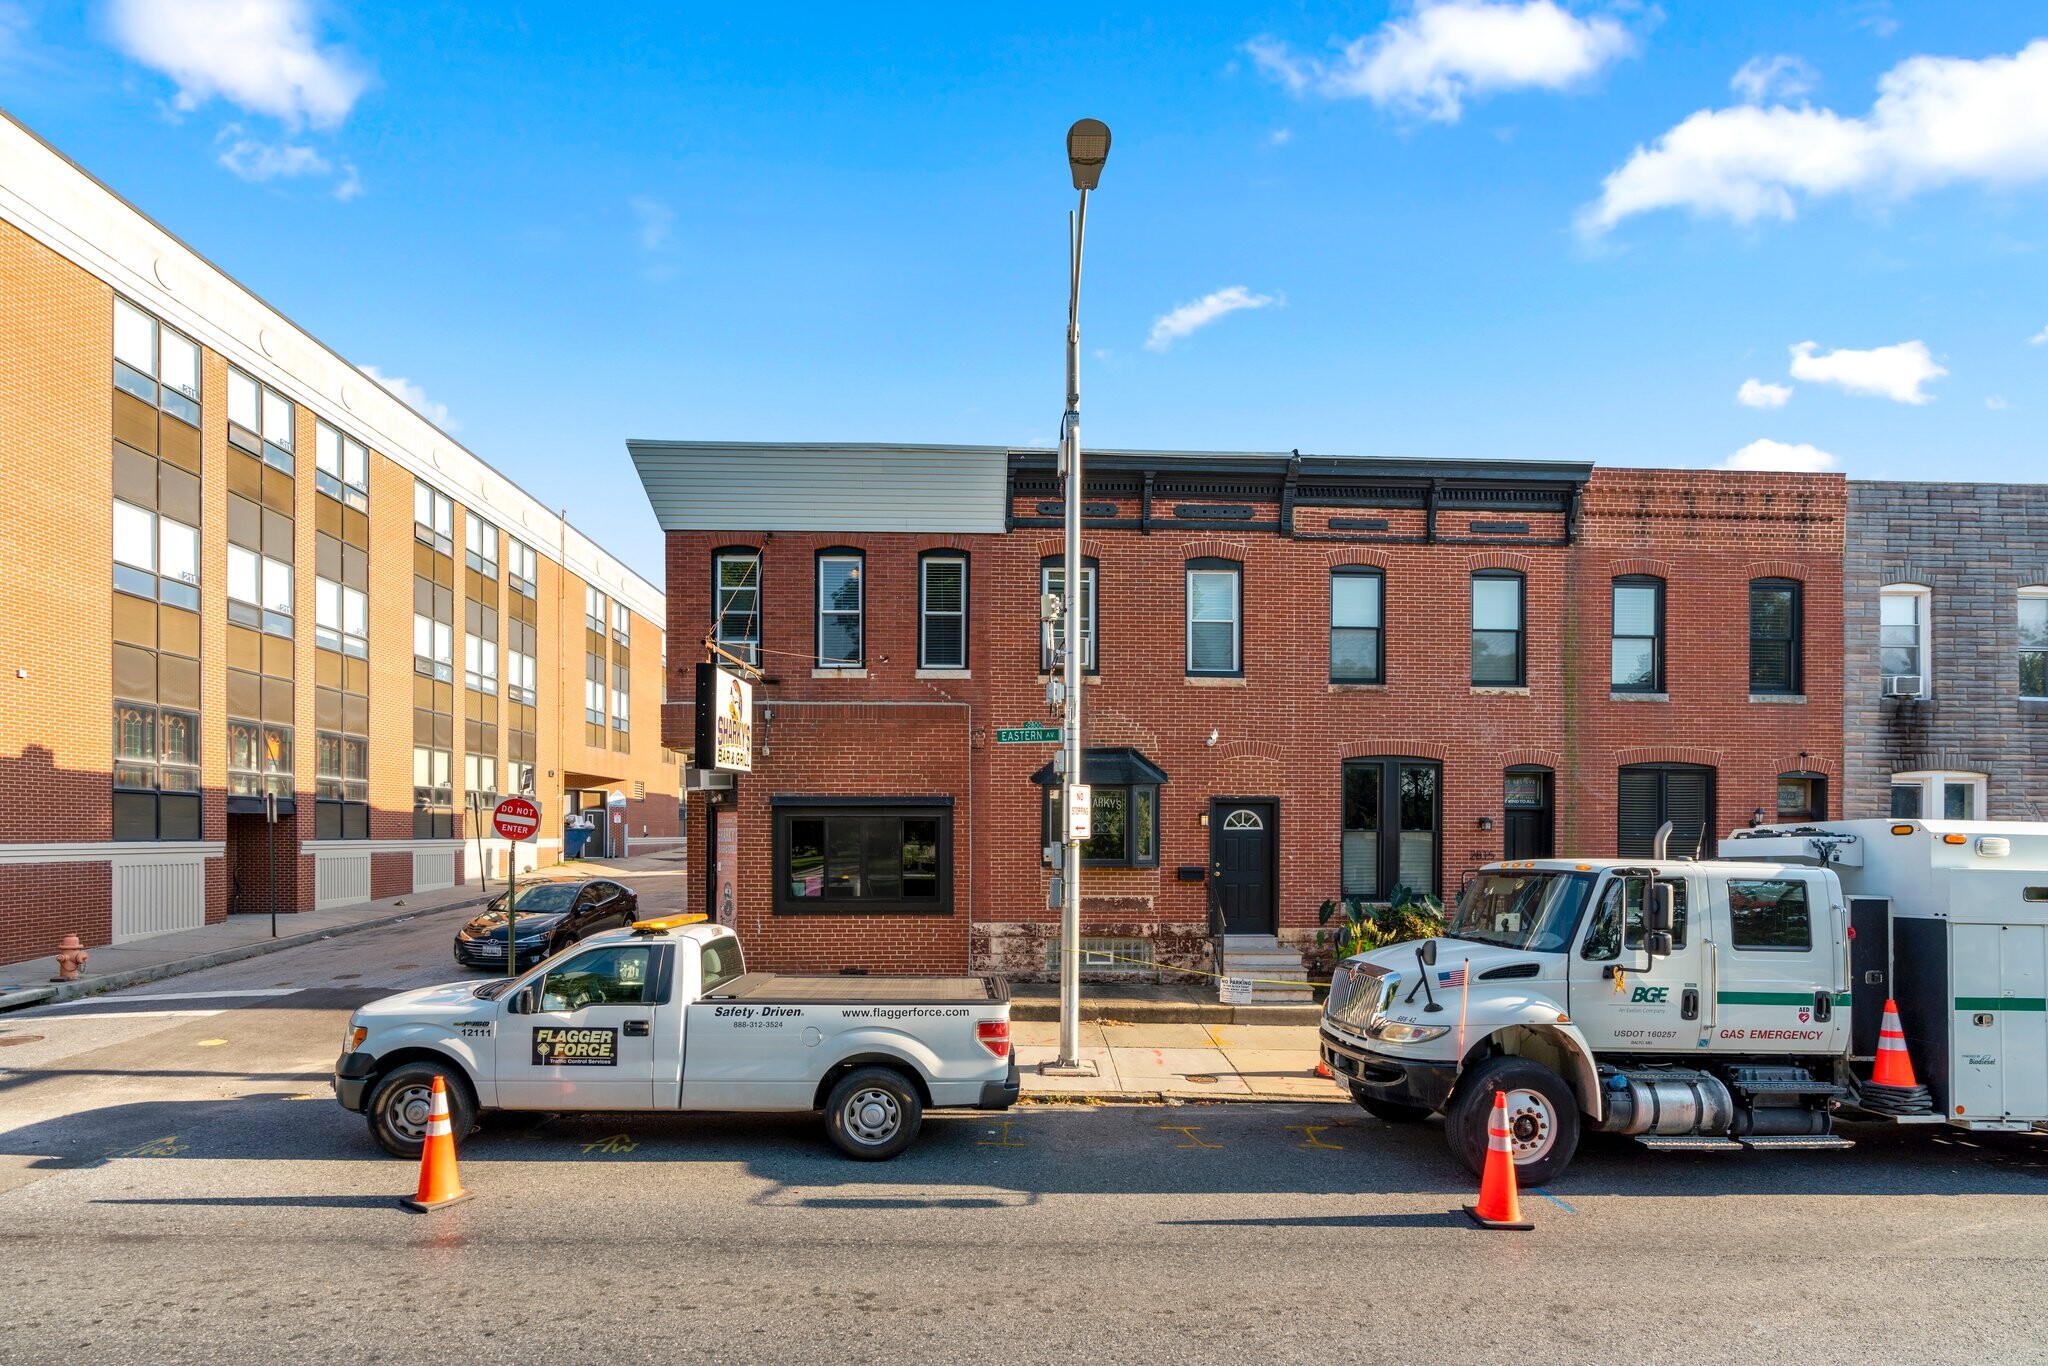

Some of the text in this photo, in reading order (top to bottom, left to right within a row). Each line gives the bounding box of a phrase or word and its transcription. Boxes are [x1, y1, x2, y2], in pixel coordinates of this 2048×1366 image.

[717, 716, 750, 752] SHARKY'S
[1001, 731, 1043, 741] EASTERN
[718, 748, 730, 764] BAR
[736, 752, 750, 767] GRILL
[1076, 792, 1084, 801] NO
[1093, 797, 1122, 810] ARKY'S
[501, 805, 534, 816] DO NOT
[1072, 807, 1089, 816] STOPPING
[501, 823, 528, 834] ENTER
[1631, 986, 1669, 1003] BGE
[714, 1006, 802, 1018] Safety Driven
[841, 1006, 970, 1019] www.flaggerforce.com
[461, 1029, 491, 1037] 12111
[537, 1030, 613, 1043] FLAGGER
[1613, 1030, 1645, 1038] USDOT
[1720, 1029, 1823, 1040] GAS EMERGENCY
[553, 1043, 611, 1057] FORCE
[1968, 1057, 1996, 1065] Biodiesel
